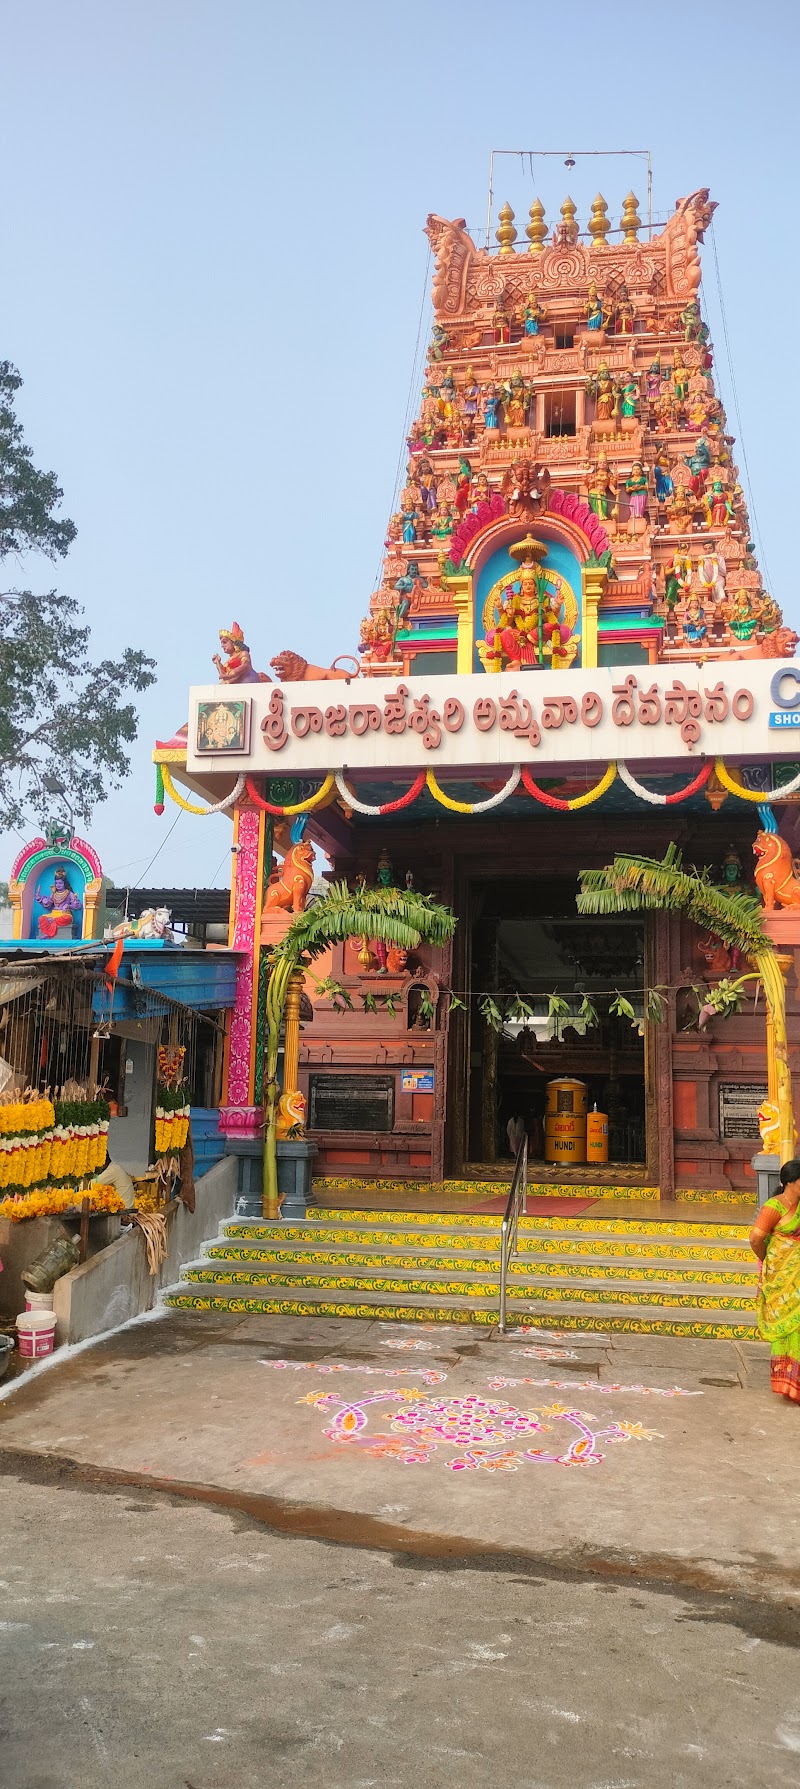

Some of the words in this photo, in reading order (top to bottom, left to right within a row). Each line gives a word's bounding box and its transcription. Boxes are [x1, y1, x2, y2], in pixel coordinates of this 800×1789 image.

[473, 689, 603, 747] అమ్మవారి
[611, 674, 755, 750] దేవస్థానం
[774, 713, 800, 725] SHO
[554, 1140, 575, 1151] HUNDI
